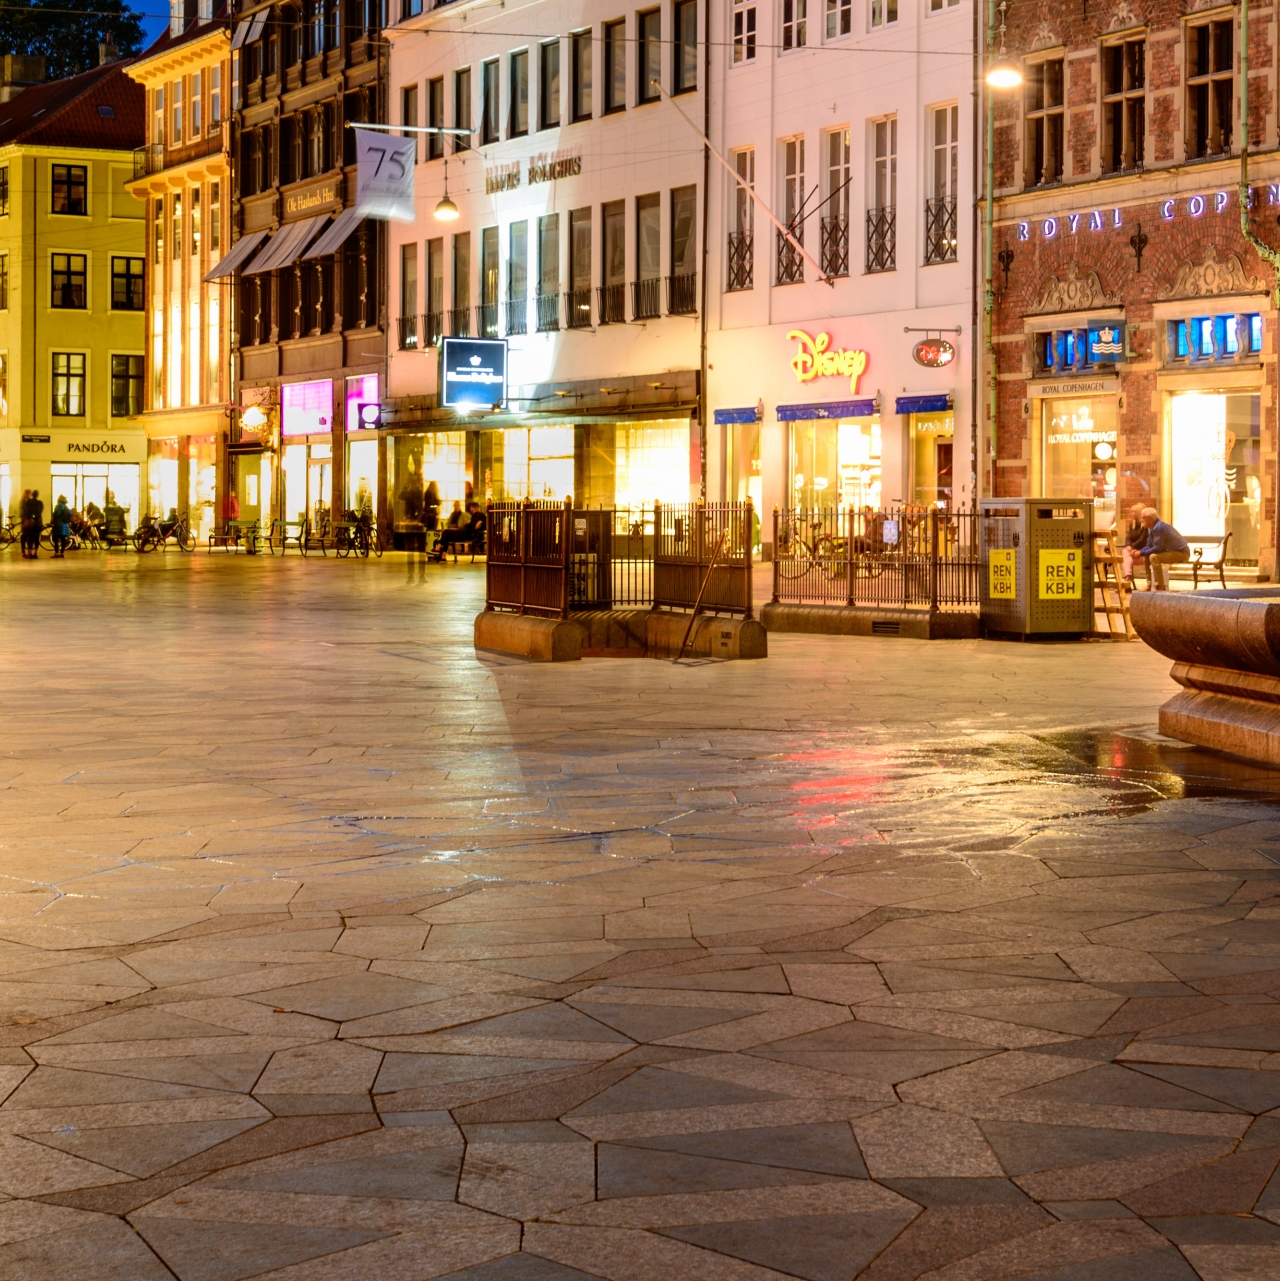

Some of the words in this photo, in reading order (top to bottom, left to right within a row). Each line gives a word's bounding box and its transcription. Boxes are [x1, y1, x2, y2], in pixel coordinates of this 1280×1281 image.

[366, 147, 406, 181] 75
[287, 197, 297, 213] Ole
[297, 189, 322, 210] Haslunds
[322, 187, 335, 203] Hus
[1017, 207, 1123, 242] ROYAL
[1042, 385, 1060, 394] ROYAL
[1062, 382, 1104, 393] COPENHAGEN
[1024, 402, 1029, 414] 6
[1118, 397, 1123, 409] 6
[1048, 433, 1072, 444] ROYAL
[993, 564, 1011, 577] REN
[1046, 565, 1076, 578] REN
[993, 582, 1012, 594] KBH
[1046, 582, 1076, 595] KBH
